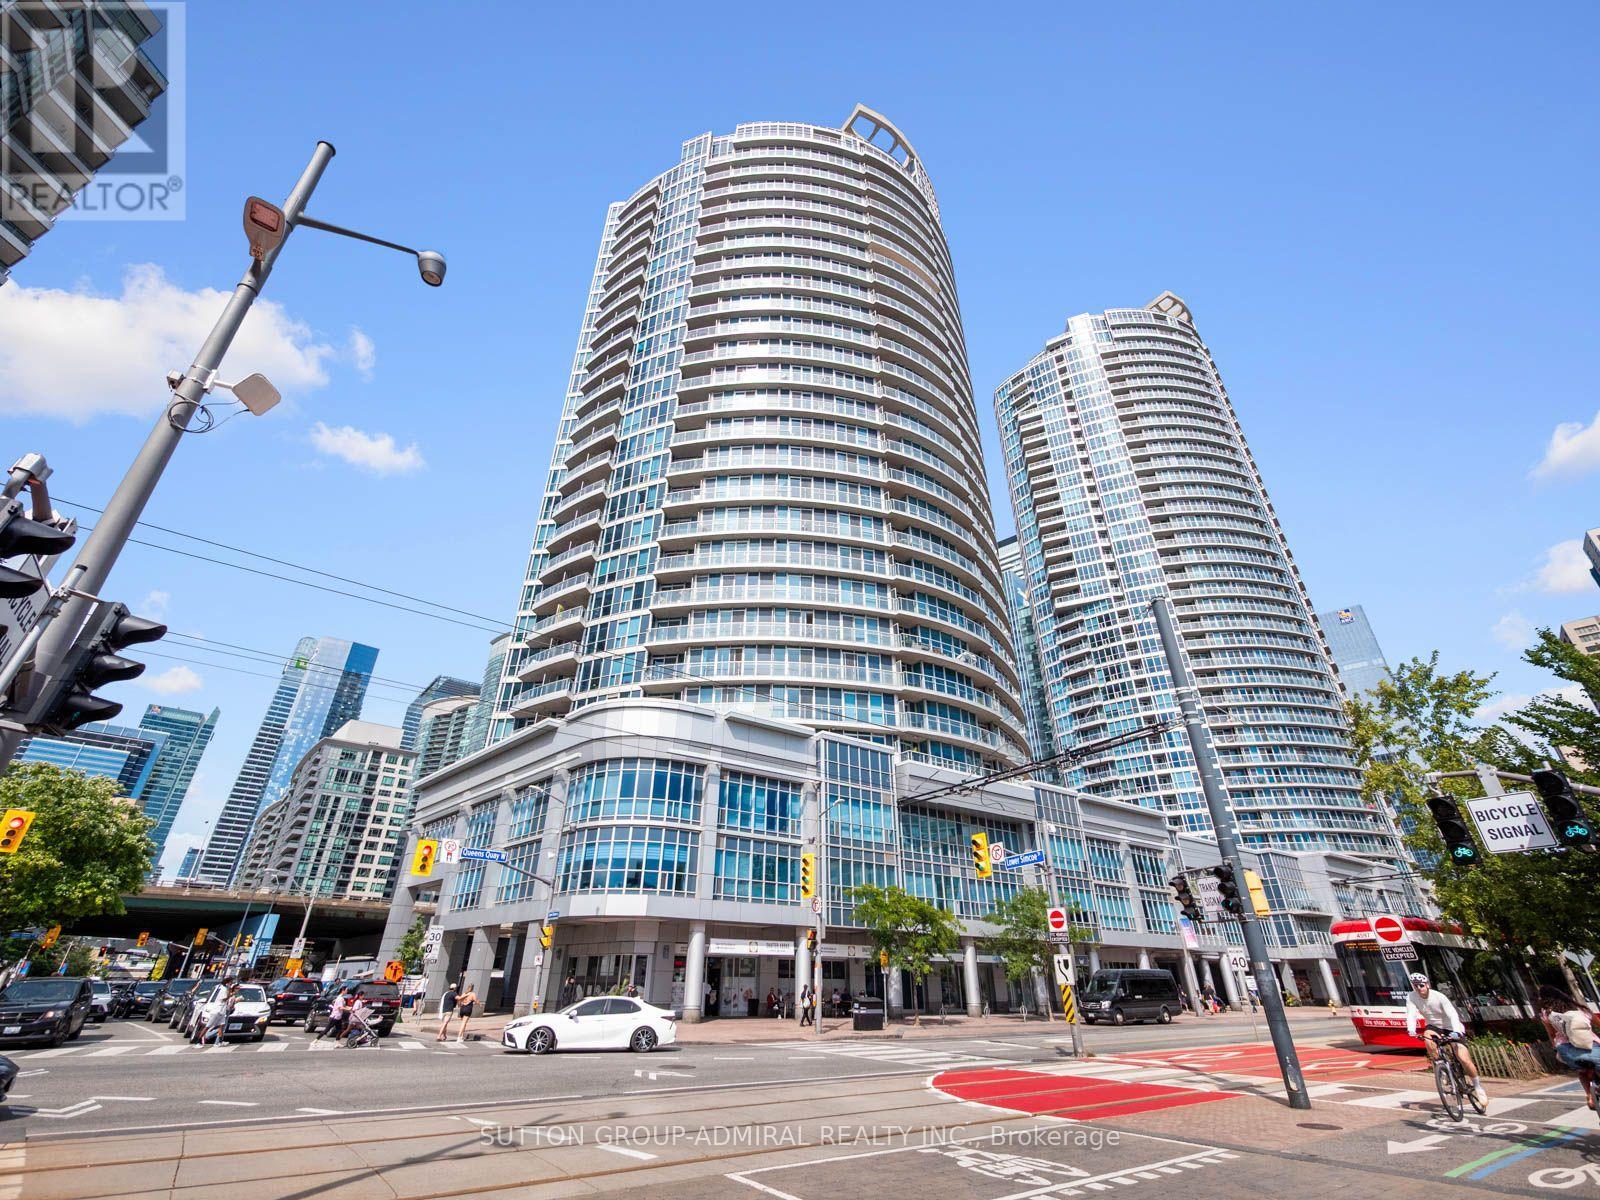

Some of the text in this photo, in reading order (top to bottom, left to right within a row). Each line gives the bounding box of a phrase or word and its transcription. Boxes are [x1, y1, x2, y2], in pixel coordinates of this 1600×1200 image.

[1475, 803, 1538, 822] BICYCLE
[1487, 823, 1544, 840] SIGNAL
[462, 848, 484, 857] Queens
[485, 851, 500, 860] Quay
[1007, 857, 1019, 866] Lower
[1020, 853, 1038, 863] Simcoe
[1199, 881, 1219, 892] TRANSIT
[1204, 896, 1222, 907] SIGNA
[429, 932, 441, 941] 30
[1392, 945, 1414, 953] VEHICLES
[1385, 952, 1415, 960] EXCEPTED
[1232, 957, 1246, 968] 40
